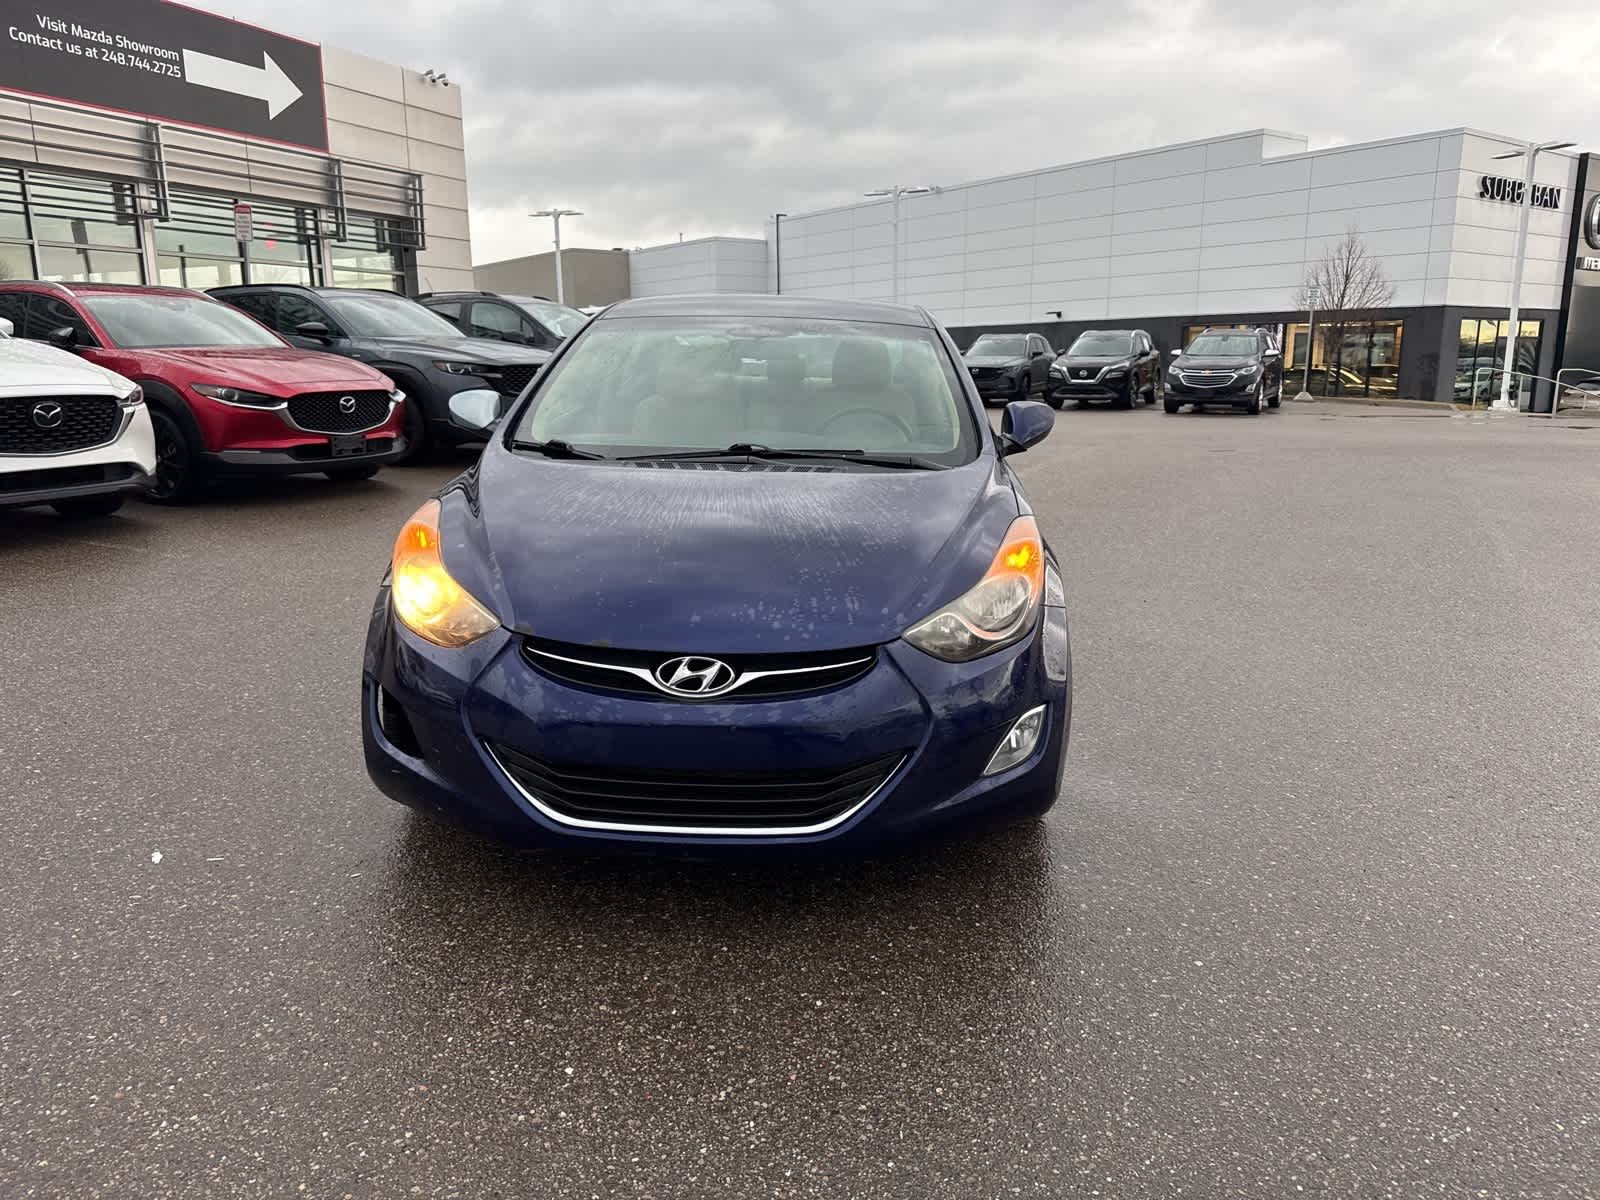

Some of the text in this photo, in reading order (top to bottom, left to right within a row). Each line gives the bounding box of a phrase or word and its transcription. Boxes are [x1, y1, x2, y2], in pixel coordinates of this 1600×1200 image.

[9, 26, 182, 78] Contact us at 248.744.2725
[36, 14, 180, 61] Visit Mazda Showroom
[1480, 175, 1561, 209] SUBUBAN
